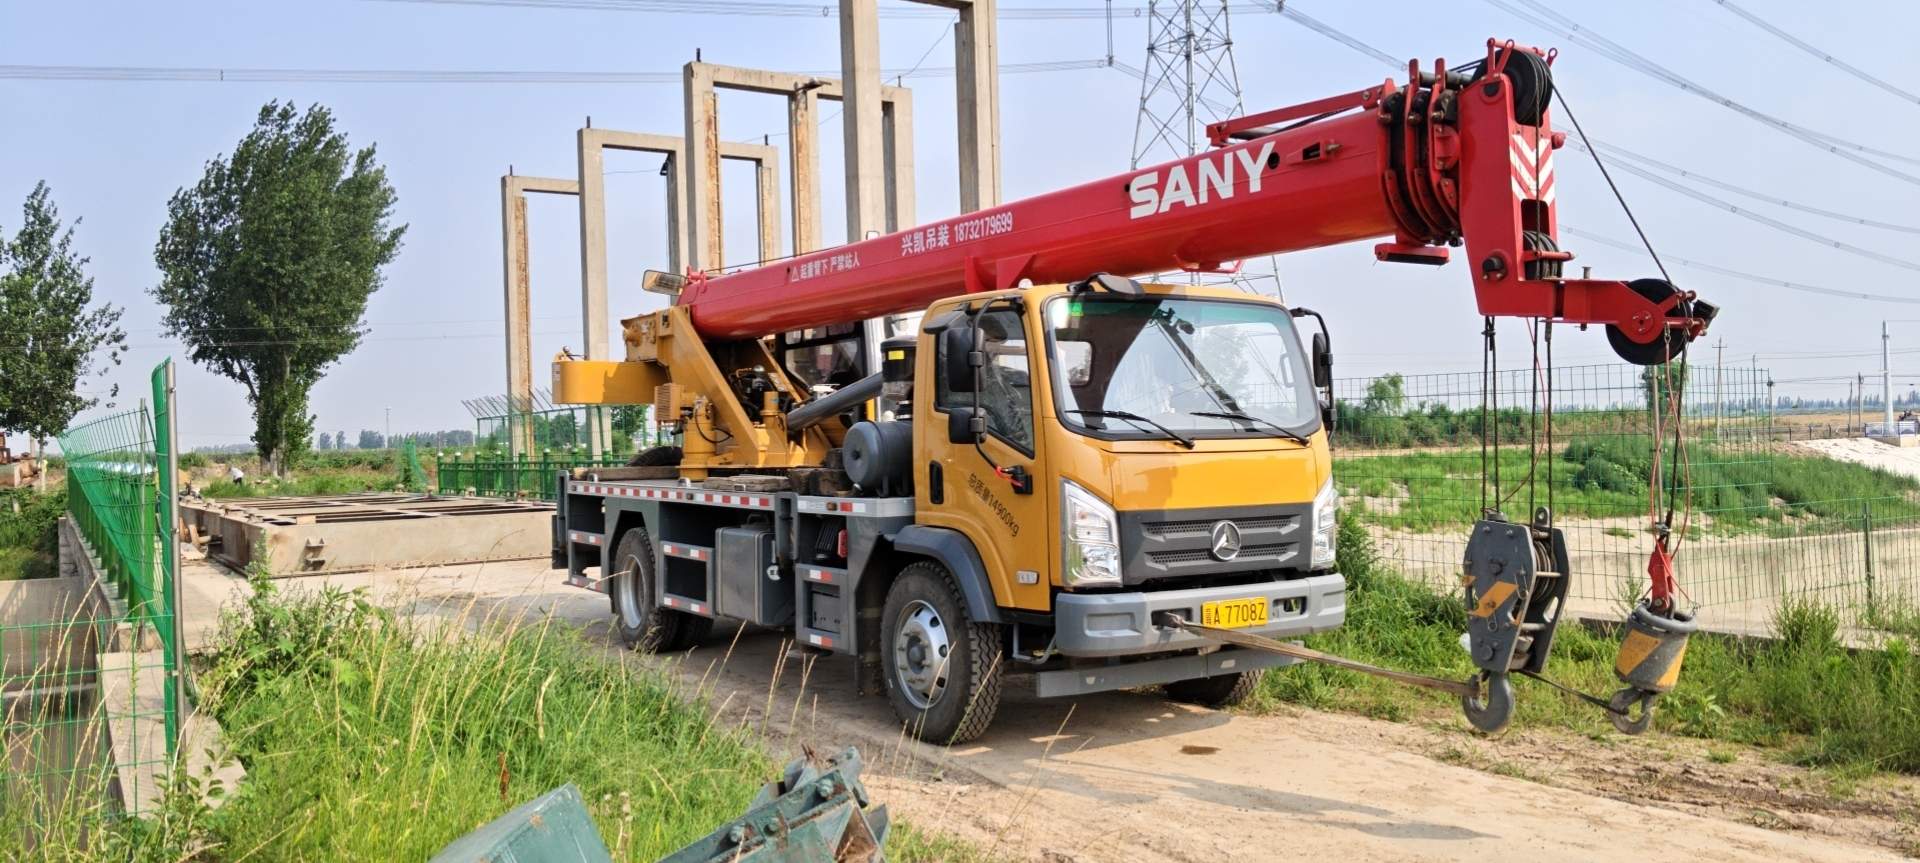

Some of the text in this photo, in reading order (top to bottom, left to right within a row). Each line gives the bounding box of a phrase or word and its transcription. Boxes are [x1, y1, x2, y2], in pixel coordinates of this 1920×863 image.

[1129, 141, 1276, 220] SANY
[901, 212, 1013, 257] 兴凯吊装 18732179699
